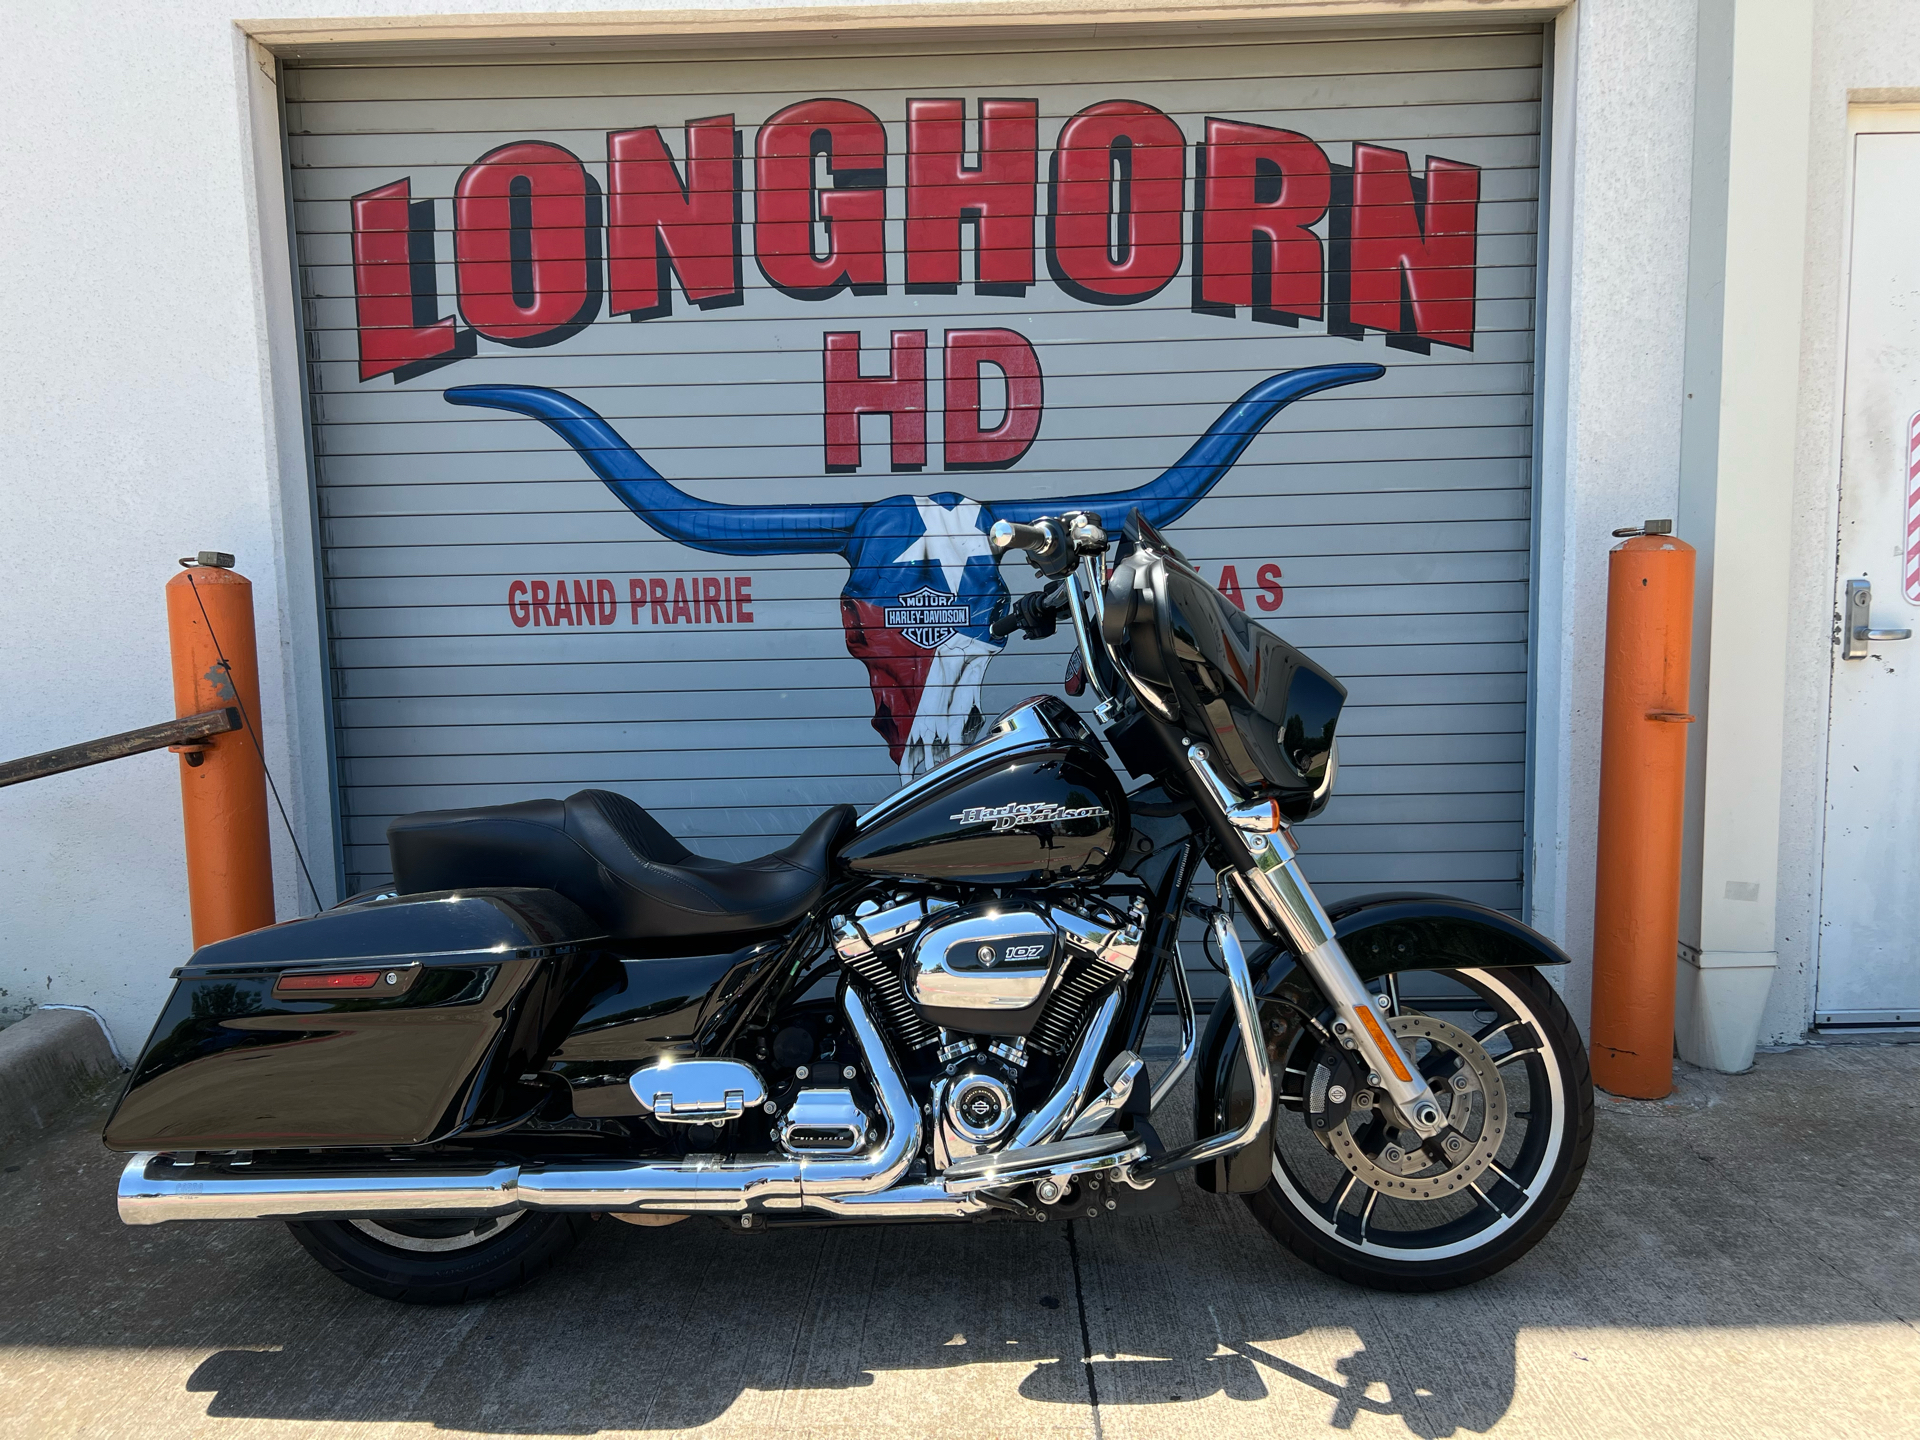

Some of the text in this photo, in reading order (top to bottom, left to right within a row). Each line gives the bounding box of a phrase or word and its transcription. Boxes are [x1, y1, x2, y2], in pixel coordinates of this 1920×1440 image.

[351, 98, 1480, 384] LONGHORN
[823, 328, 1043, 473] HD
[508, 576, 754, 628] GRAND PRAIRIE
[907, 592, 947, 606] MOTOR
[888, 609, 966, 624] HARLEY-DAVIDSON
[907, 627, 949, 646] CYCLES
[1005, 945, 1044, 958] 107
